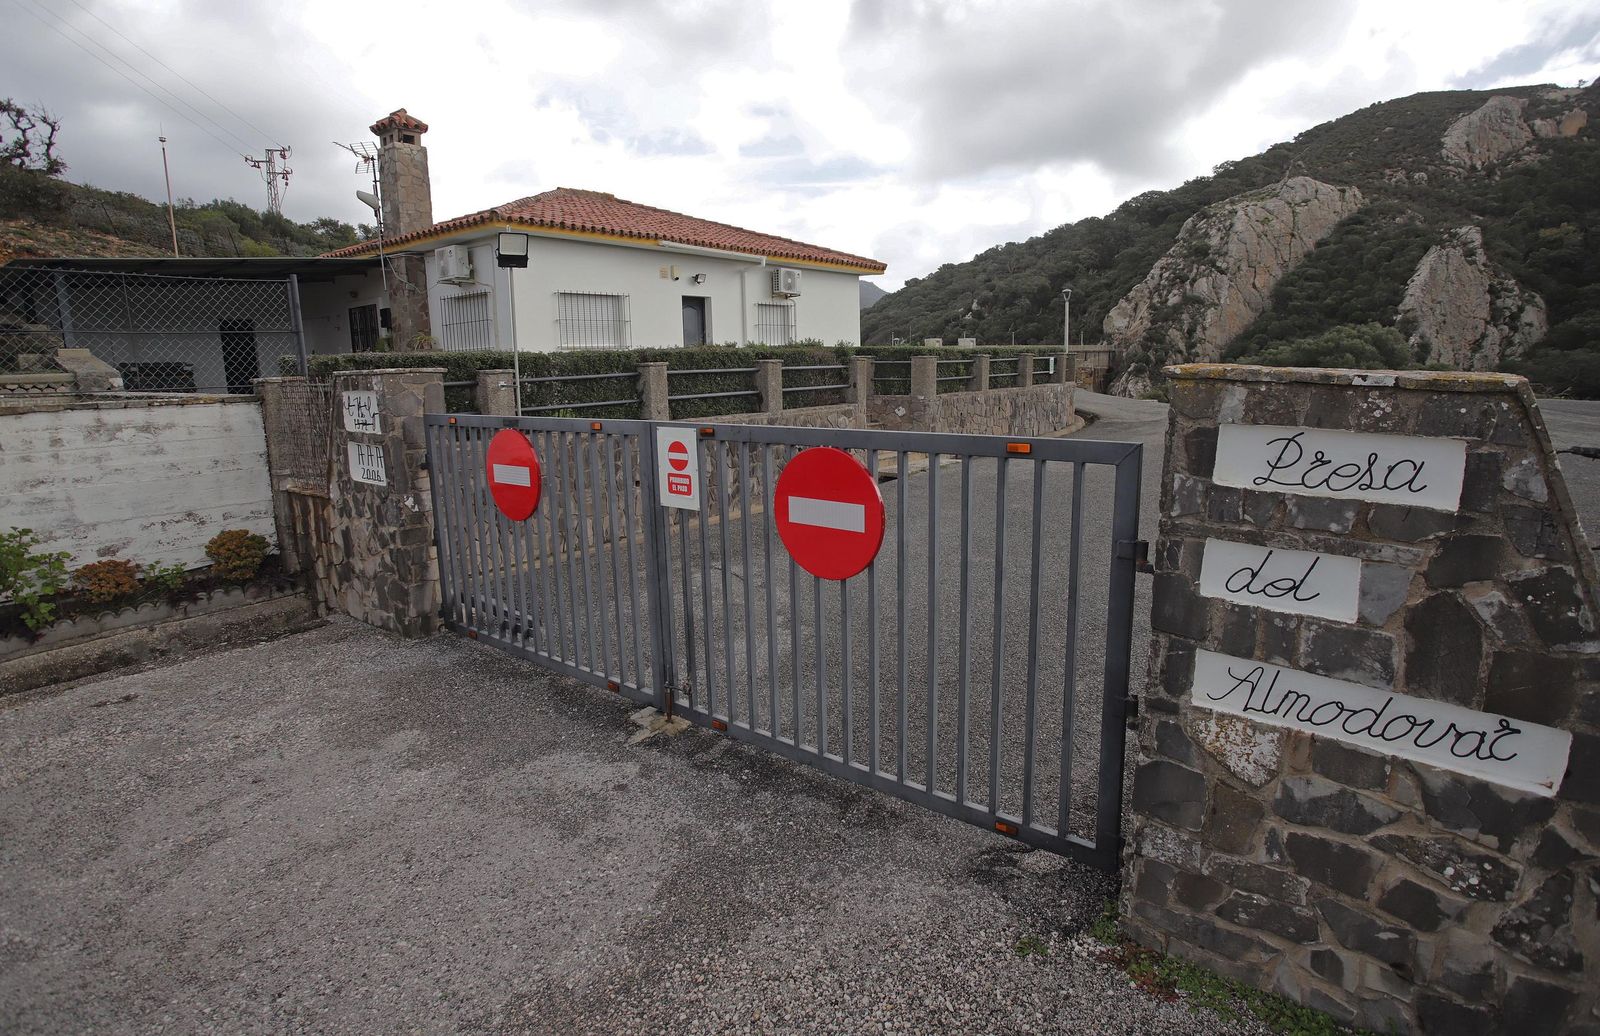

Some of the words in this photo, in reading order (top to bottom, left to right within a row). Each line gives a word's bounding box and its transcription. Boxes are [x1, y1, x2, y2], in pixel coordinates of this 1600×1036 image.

[1252, 431, 1428, 493] Presa
[1224, 549, 1321, 602] del
[1206, 666, 1522, 762] Almodovar
